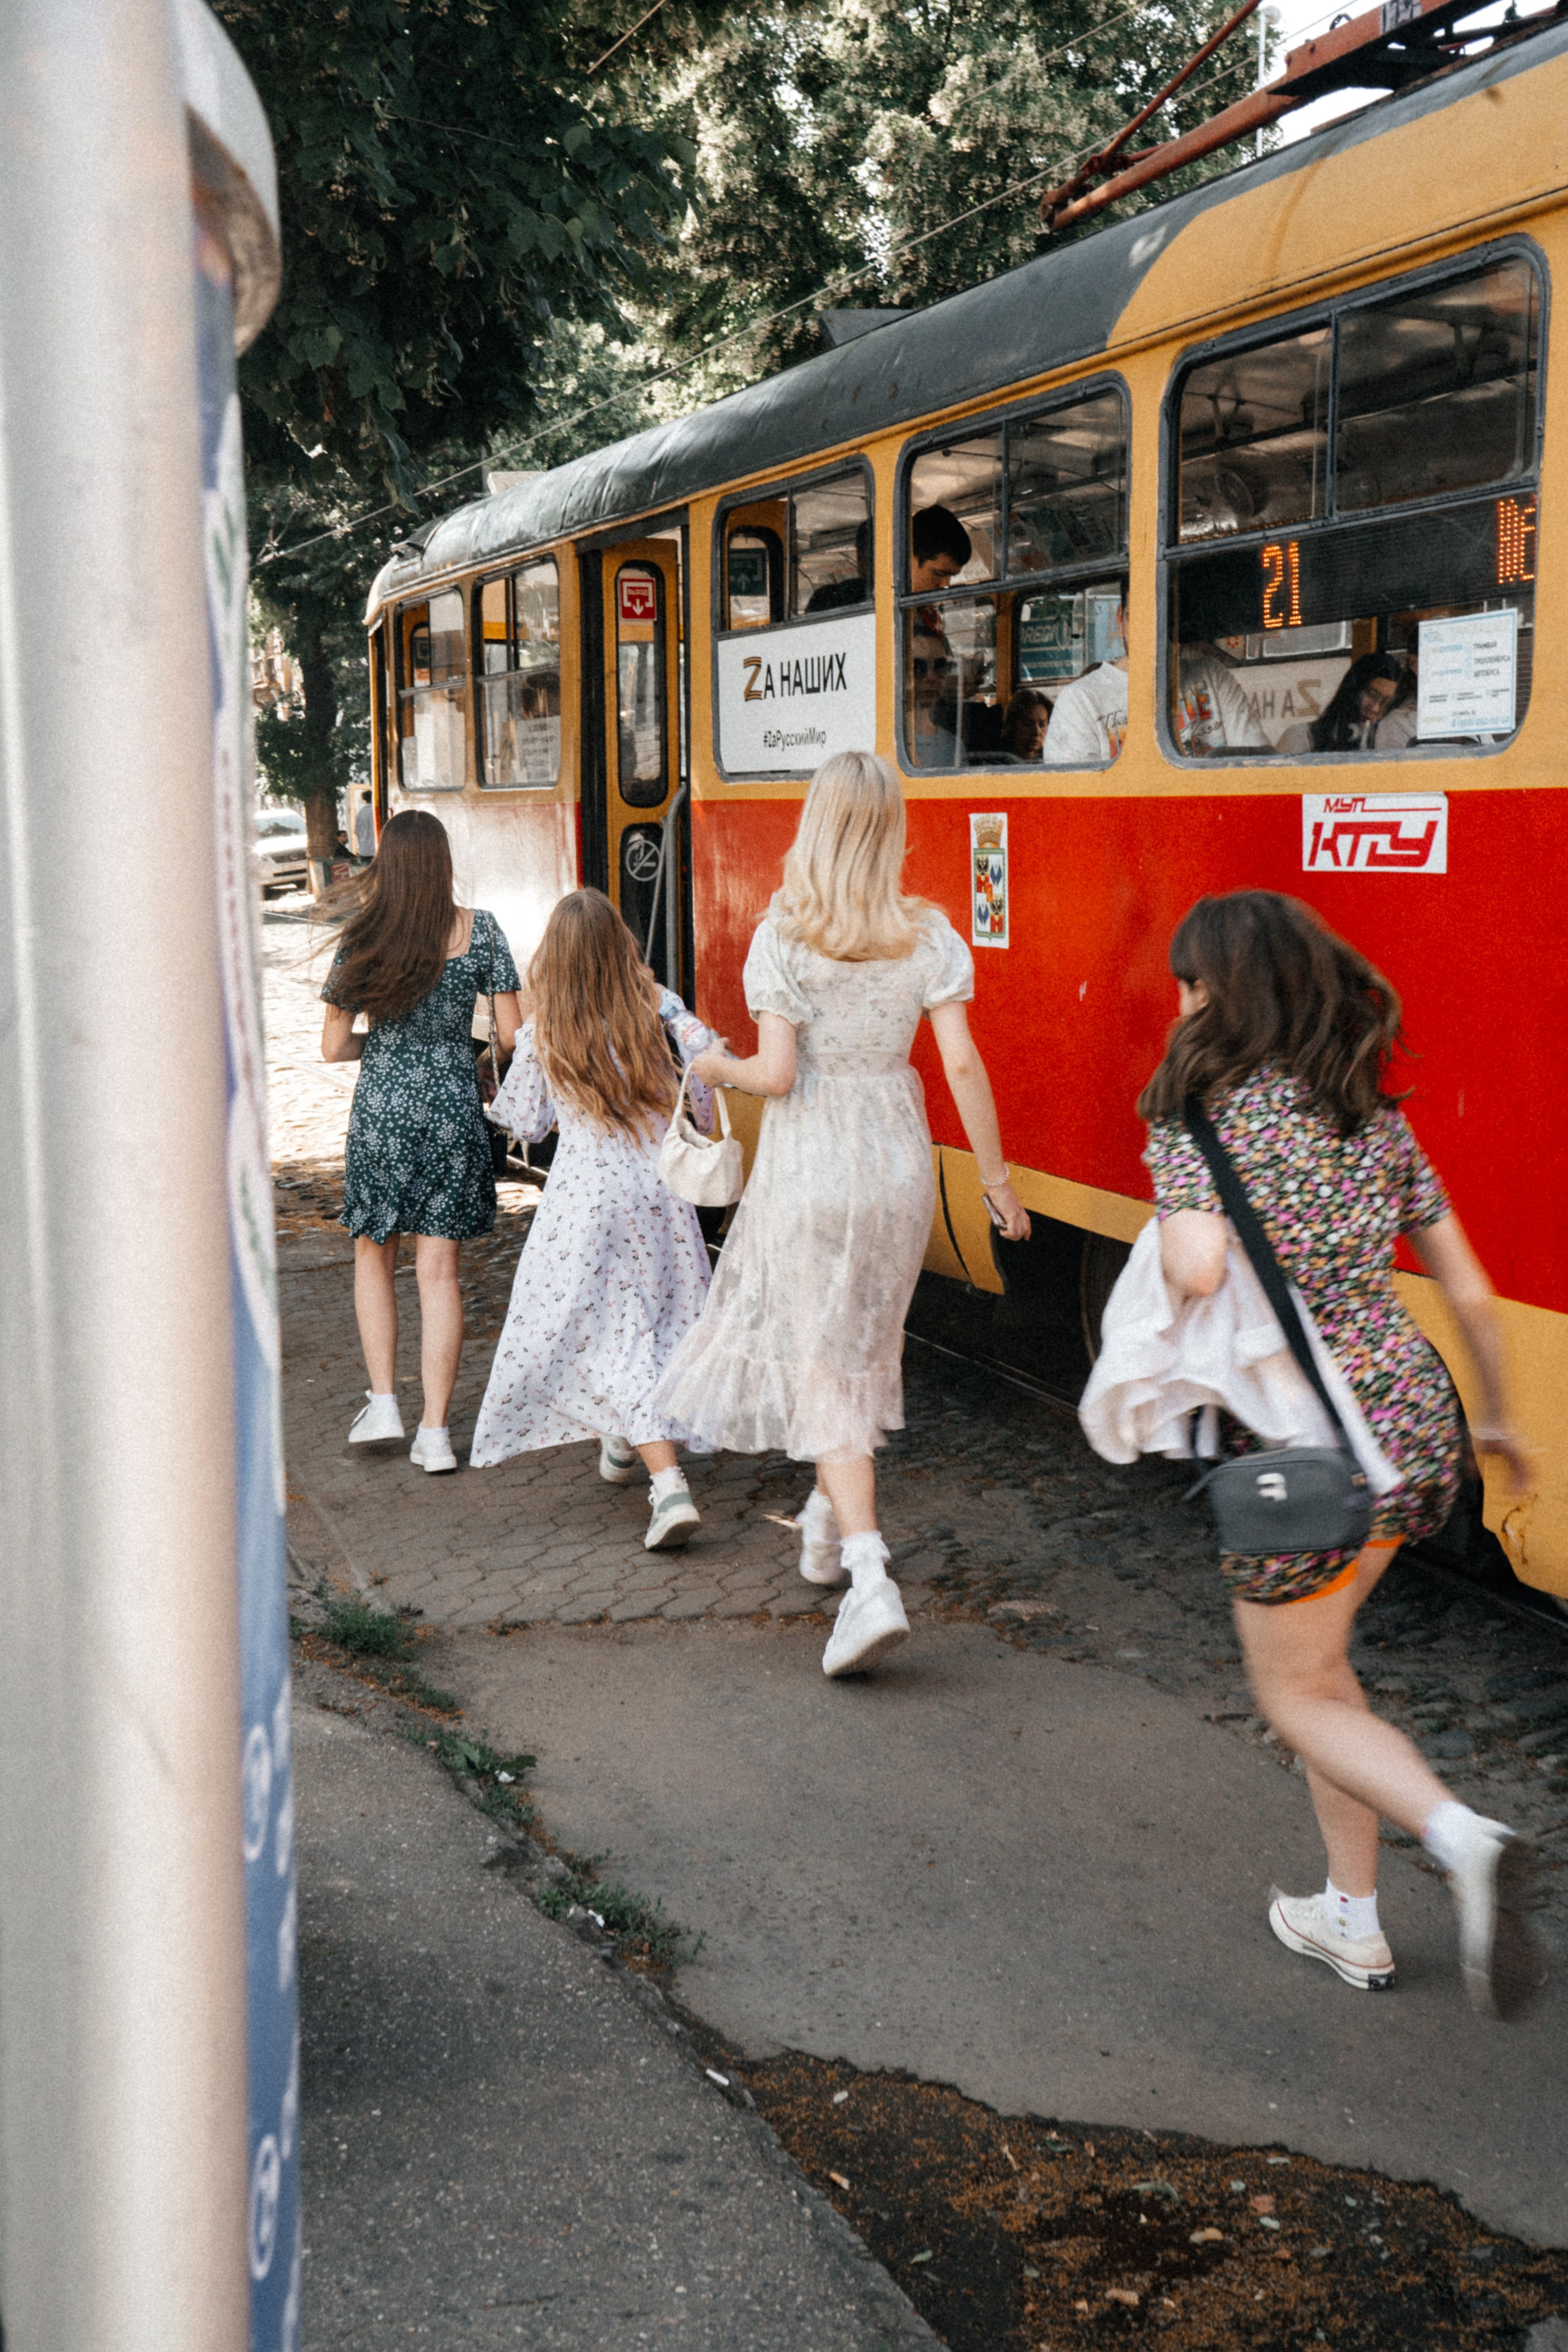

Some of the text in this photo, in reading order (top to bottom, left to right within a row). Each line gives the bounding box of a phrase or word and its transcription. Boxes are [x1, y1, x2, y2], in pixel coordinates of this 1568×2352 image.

[1262, 542, 1302, 629] 21
[780, 652, 848, 698] НАШИХ
[1323, 797, 1366, 813] МУП
